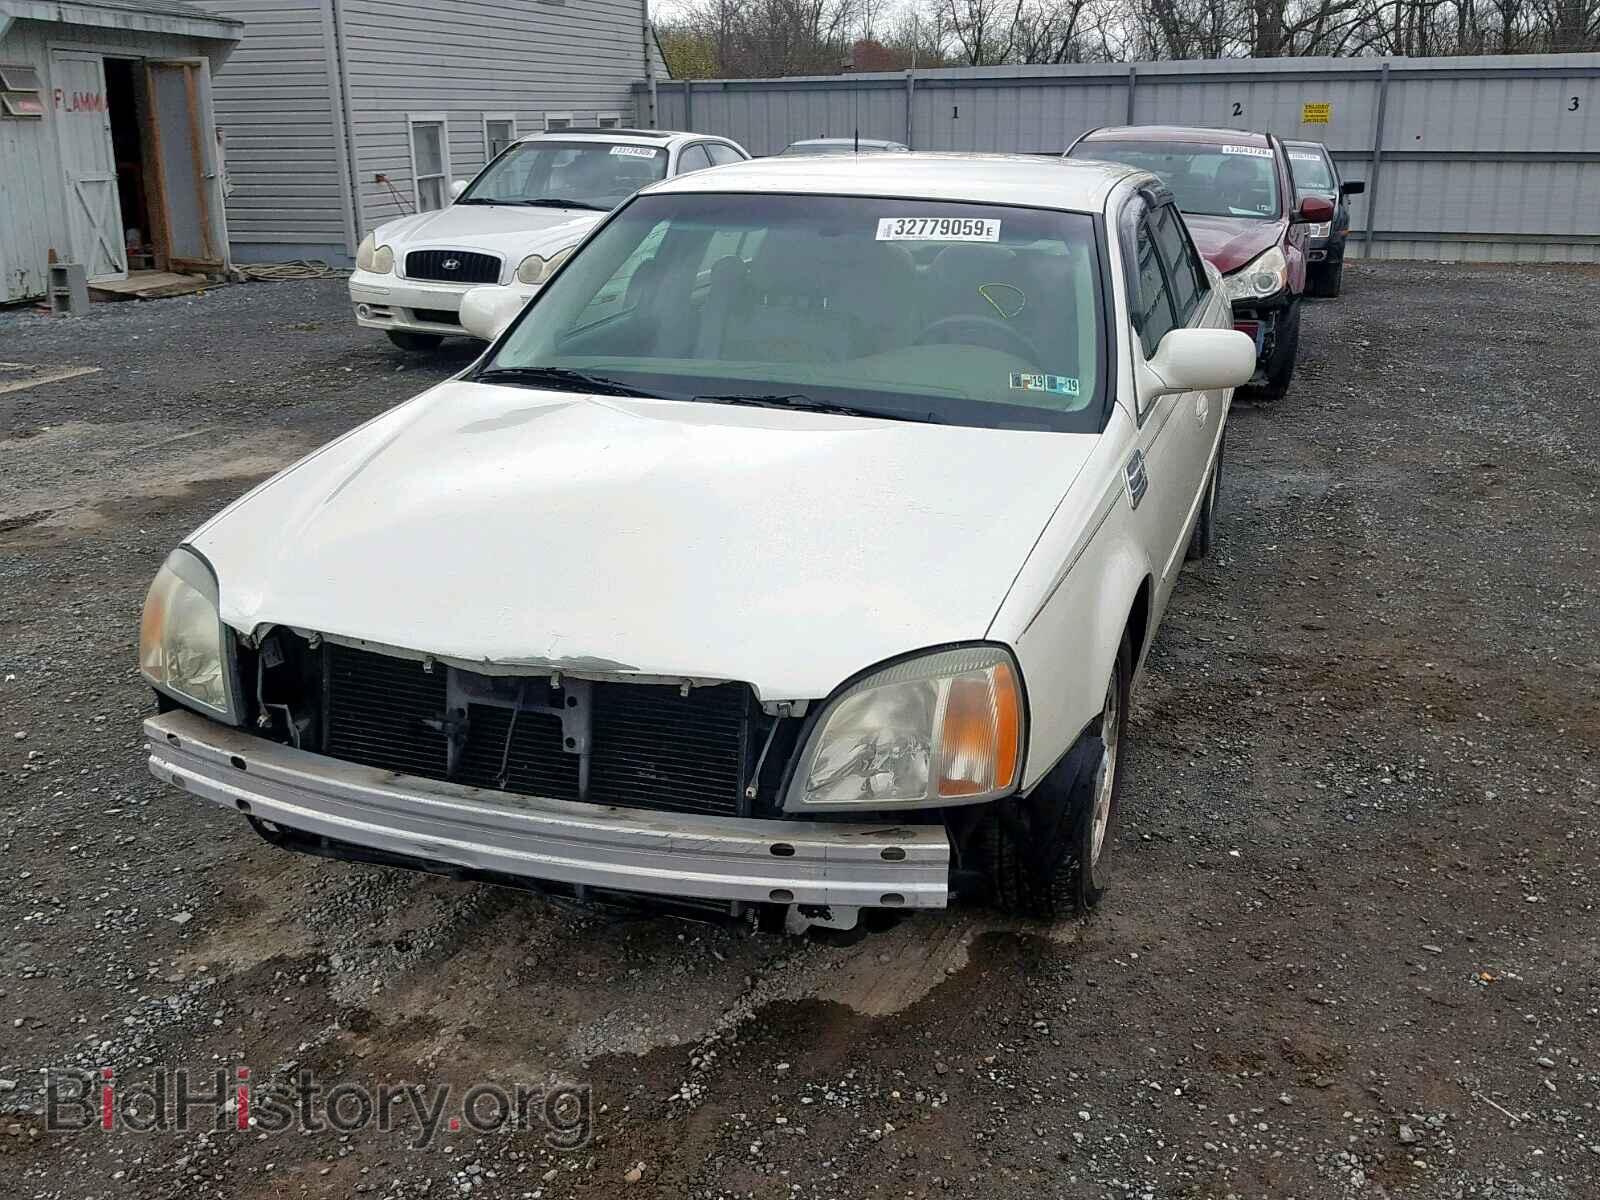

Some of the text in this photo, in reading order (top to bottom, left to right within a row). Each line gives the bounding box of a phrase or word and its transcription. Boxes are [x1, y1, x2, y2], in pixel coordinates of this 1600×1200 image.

[1232, 102, 1243, 117] 2
[1568, 96, 1579, 112] 3
[952, 106, 960, 118] 1
[1033, 375, 1043, 388] 19
[1067, 379, 1078, 392] 19
